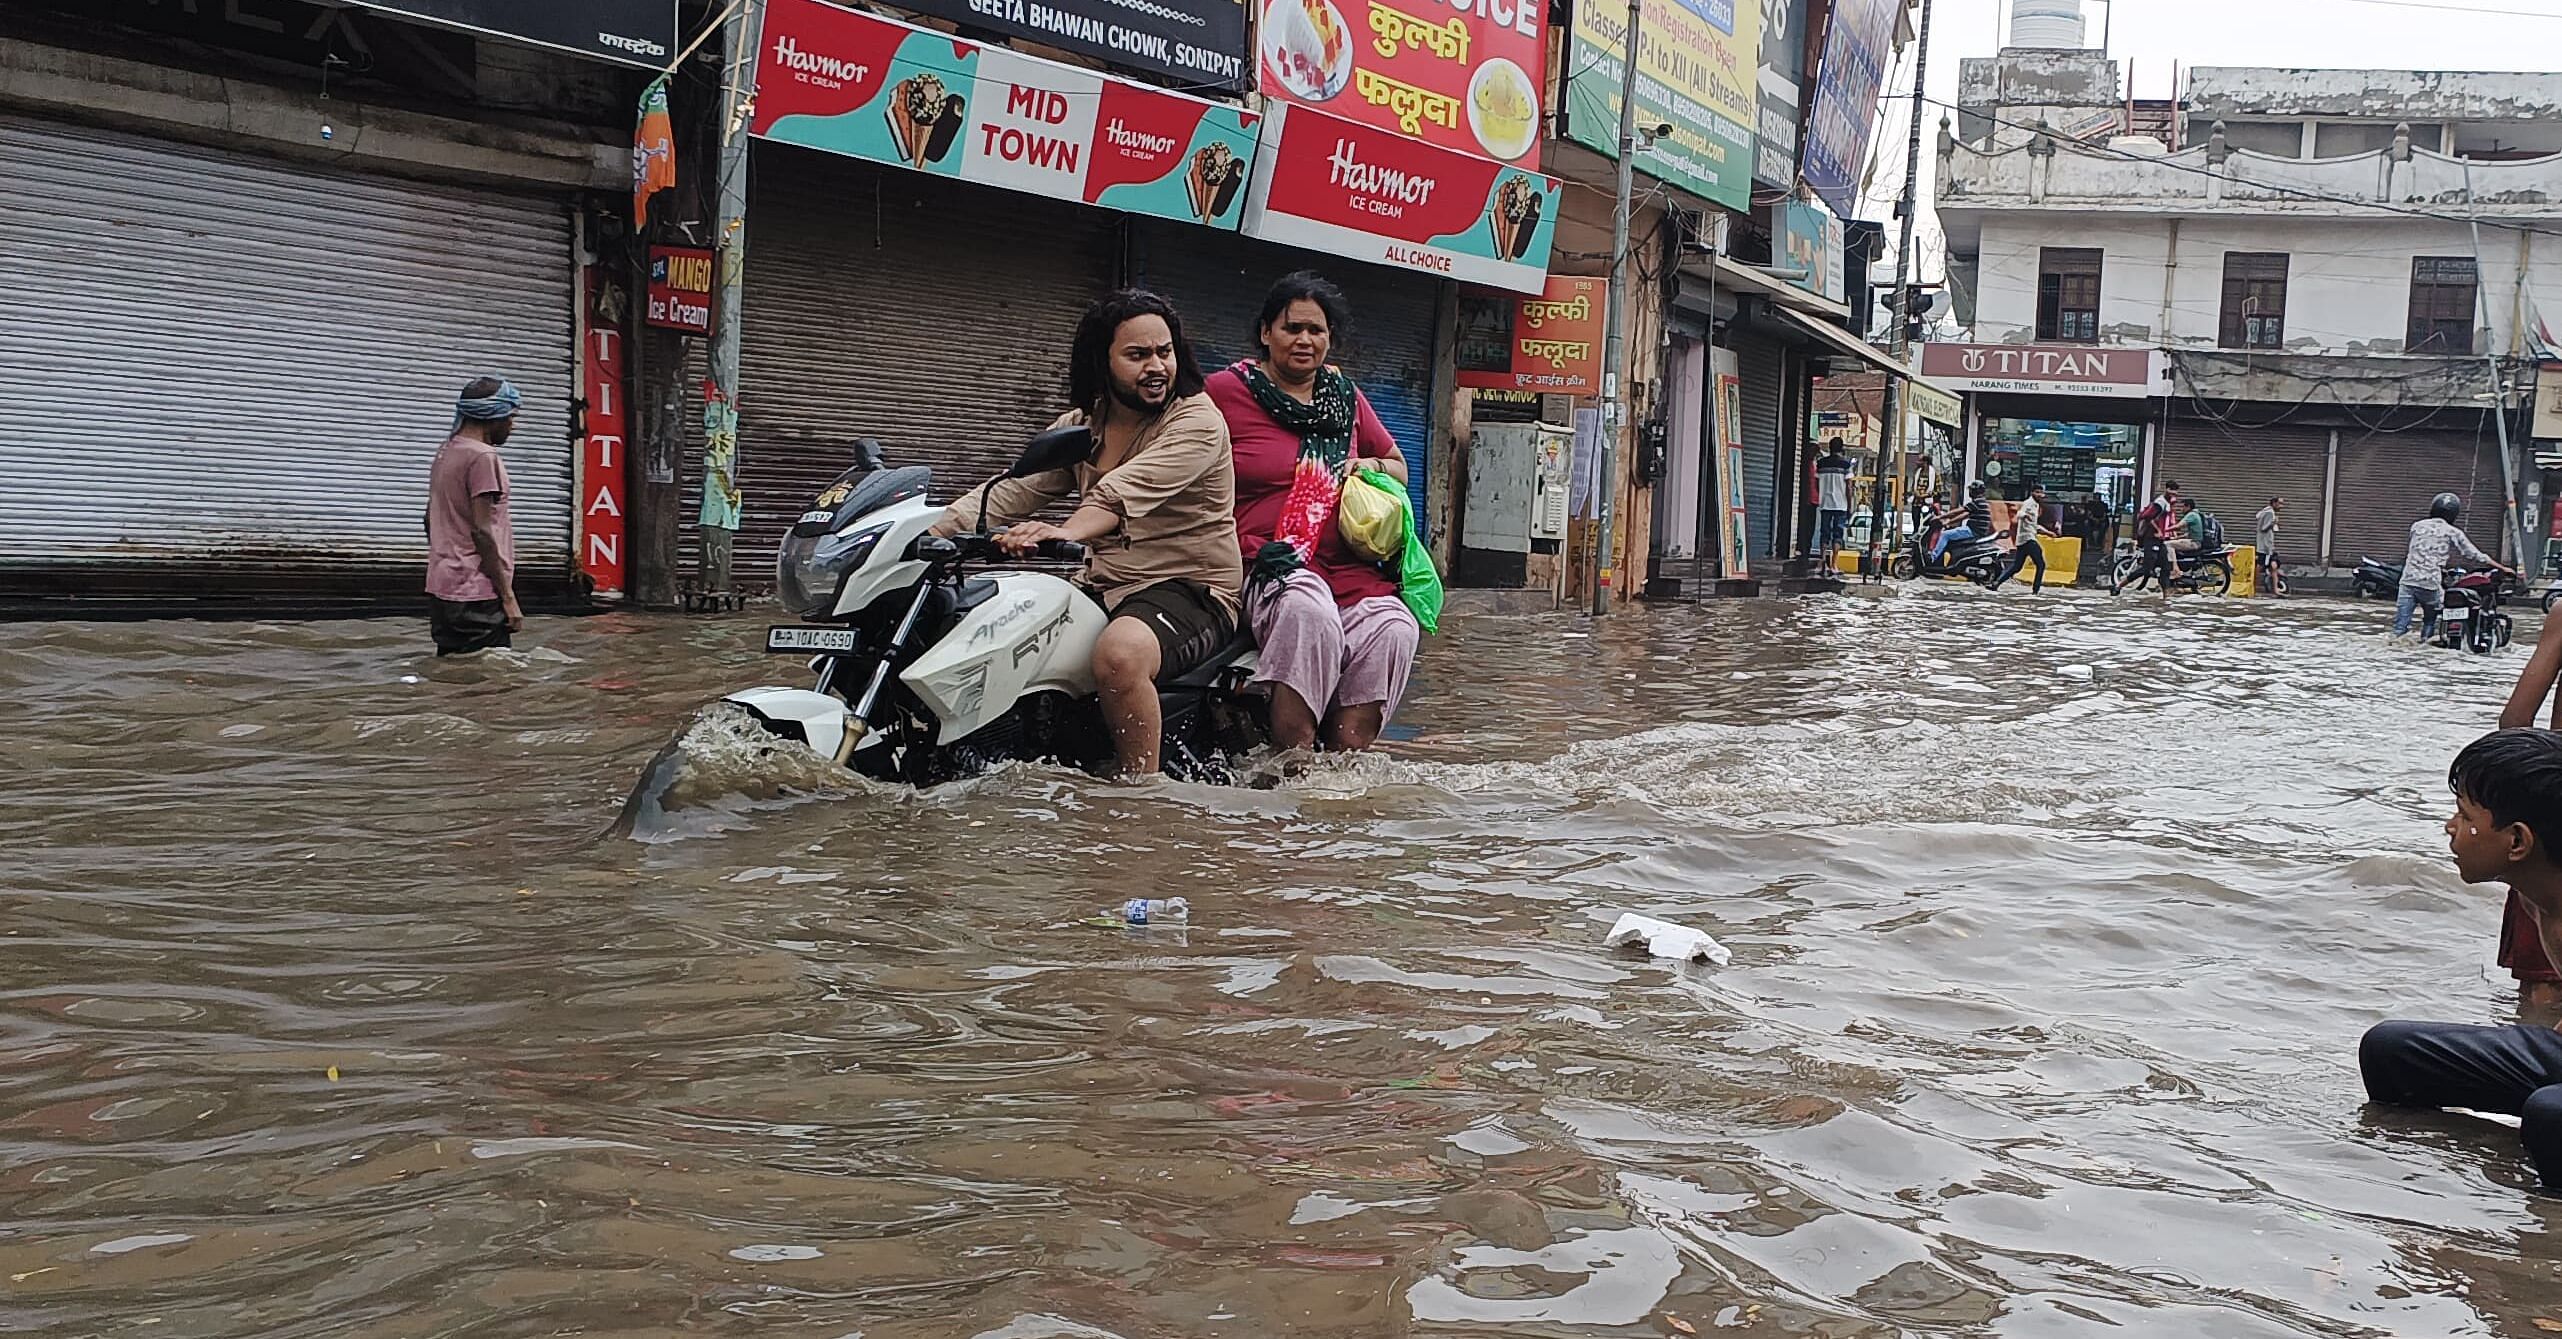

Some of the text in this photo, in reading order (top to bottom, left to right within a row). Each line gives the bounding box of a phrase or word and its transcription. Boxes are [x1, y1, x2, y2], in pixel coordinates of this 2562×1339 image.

[969, 0, 1242, 80] GEETA BHAWAN CHOWK, SONIPAT
[1367, 0, 1472, 66] कुल्फी
[772, 35, 868, 83] Havmor
[794, 72, 841, 90] ICE CREAM
[1657, 43, 1669, 72] to
[1689, 60, 1707, 95] (All
[1709, 71, 1751, 124] Streams)
[1006, 83, 1068, 125] MID
[1354, 66, 1462, 136] फलूदा
[980, 123, 1080, 173] TOWN
[1105, 117, 1176, 154] Havmor
[1120, 148, 1155, 161] ICE CREAM
[1326, 138, 1435, 206] Havmor
[1349, 194, 1403, 219] ICE CREAM
[667, 255, 712, 293] MANGO
[1384, 245, 1452, 272] ALL CHOICE
[648, 293, 709, 329] Ice Cream
[1522, 295, 1592, 329] कुल्फी
[1519, 338, 1591, 369] फलूदा
[1991, 350, 2109, 377] TITAN
[1970, 380, 2011, 390] NARANG
[2014, 381, 2040, 391] TIMES
[586, 328, 622, 567] TITAN
[965, 599, 1036, 652] Apache
